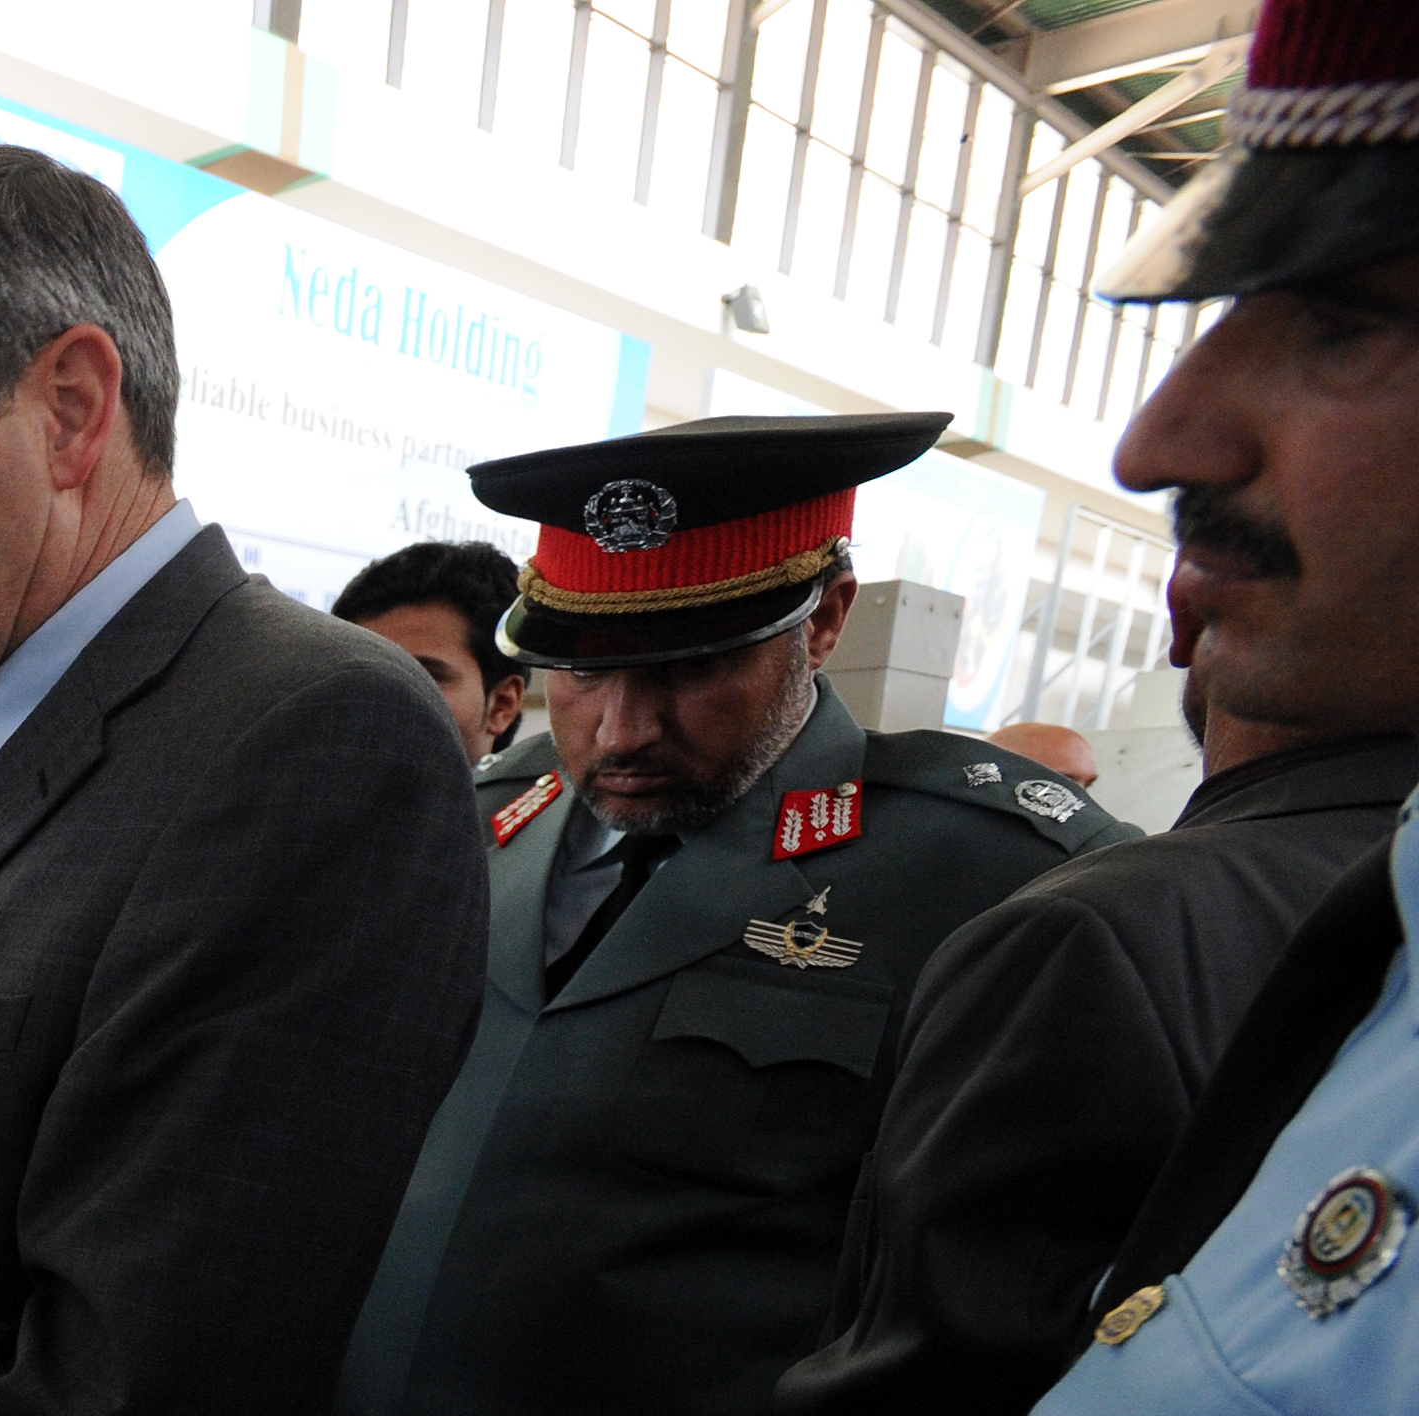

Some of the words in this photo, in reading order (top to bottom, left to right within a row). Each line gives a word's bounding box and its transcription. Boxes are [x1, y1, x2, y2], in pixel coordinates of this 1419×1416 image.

[277, 241, 381, 347] Neda
[398, 285, 543, 401] Holding
[281, 393, 391, 451] business
